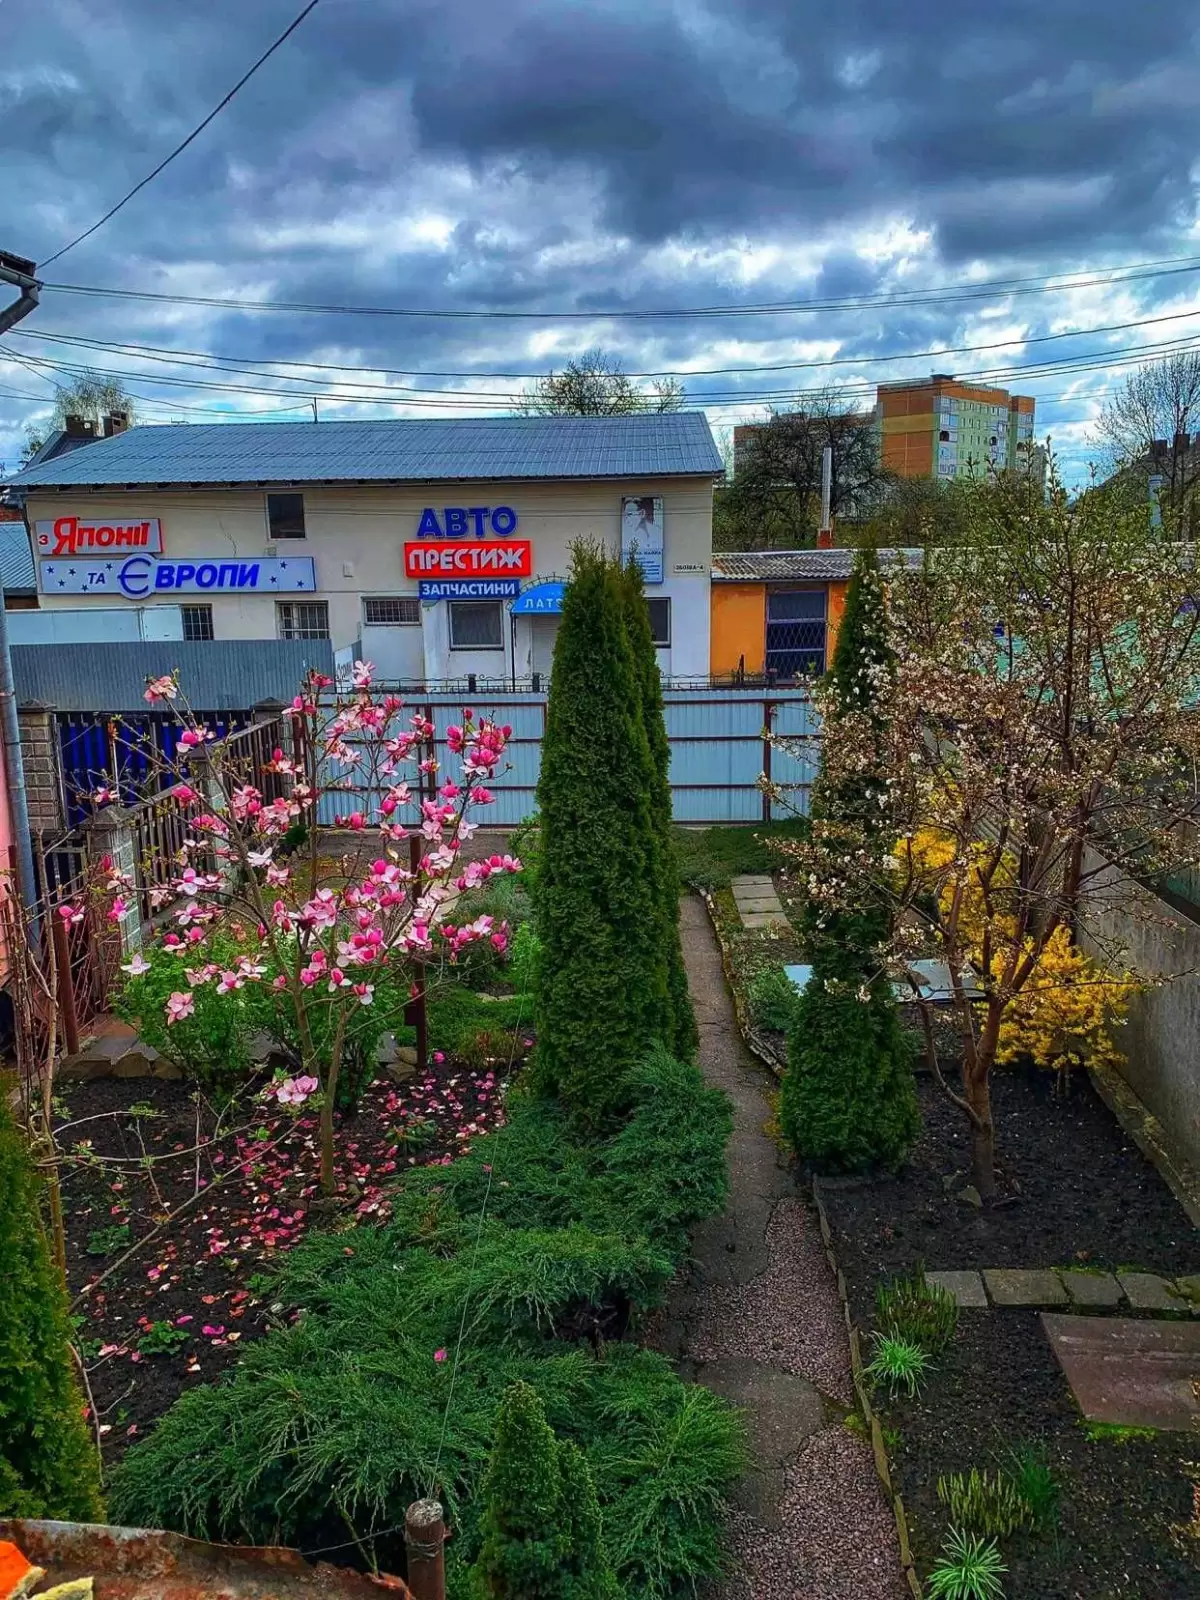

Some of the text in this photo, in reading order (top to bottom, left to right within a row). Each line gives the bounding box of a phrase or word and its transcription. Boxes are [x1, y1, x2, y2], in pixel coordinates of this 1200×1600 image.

[416, 506, 517, 539] АВТО
[408, 547, 526, 570] ПРЕСТИЖ
[87, 557, 260, 594] ТА ЄВРОПИ
[421, 582, 516, 596] ЗАПЧАСТИНИ
